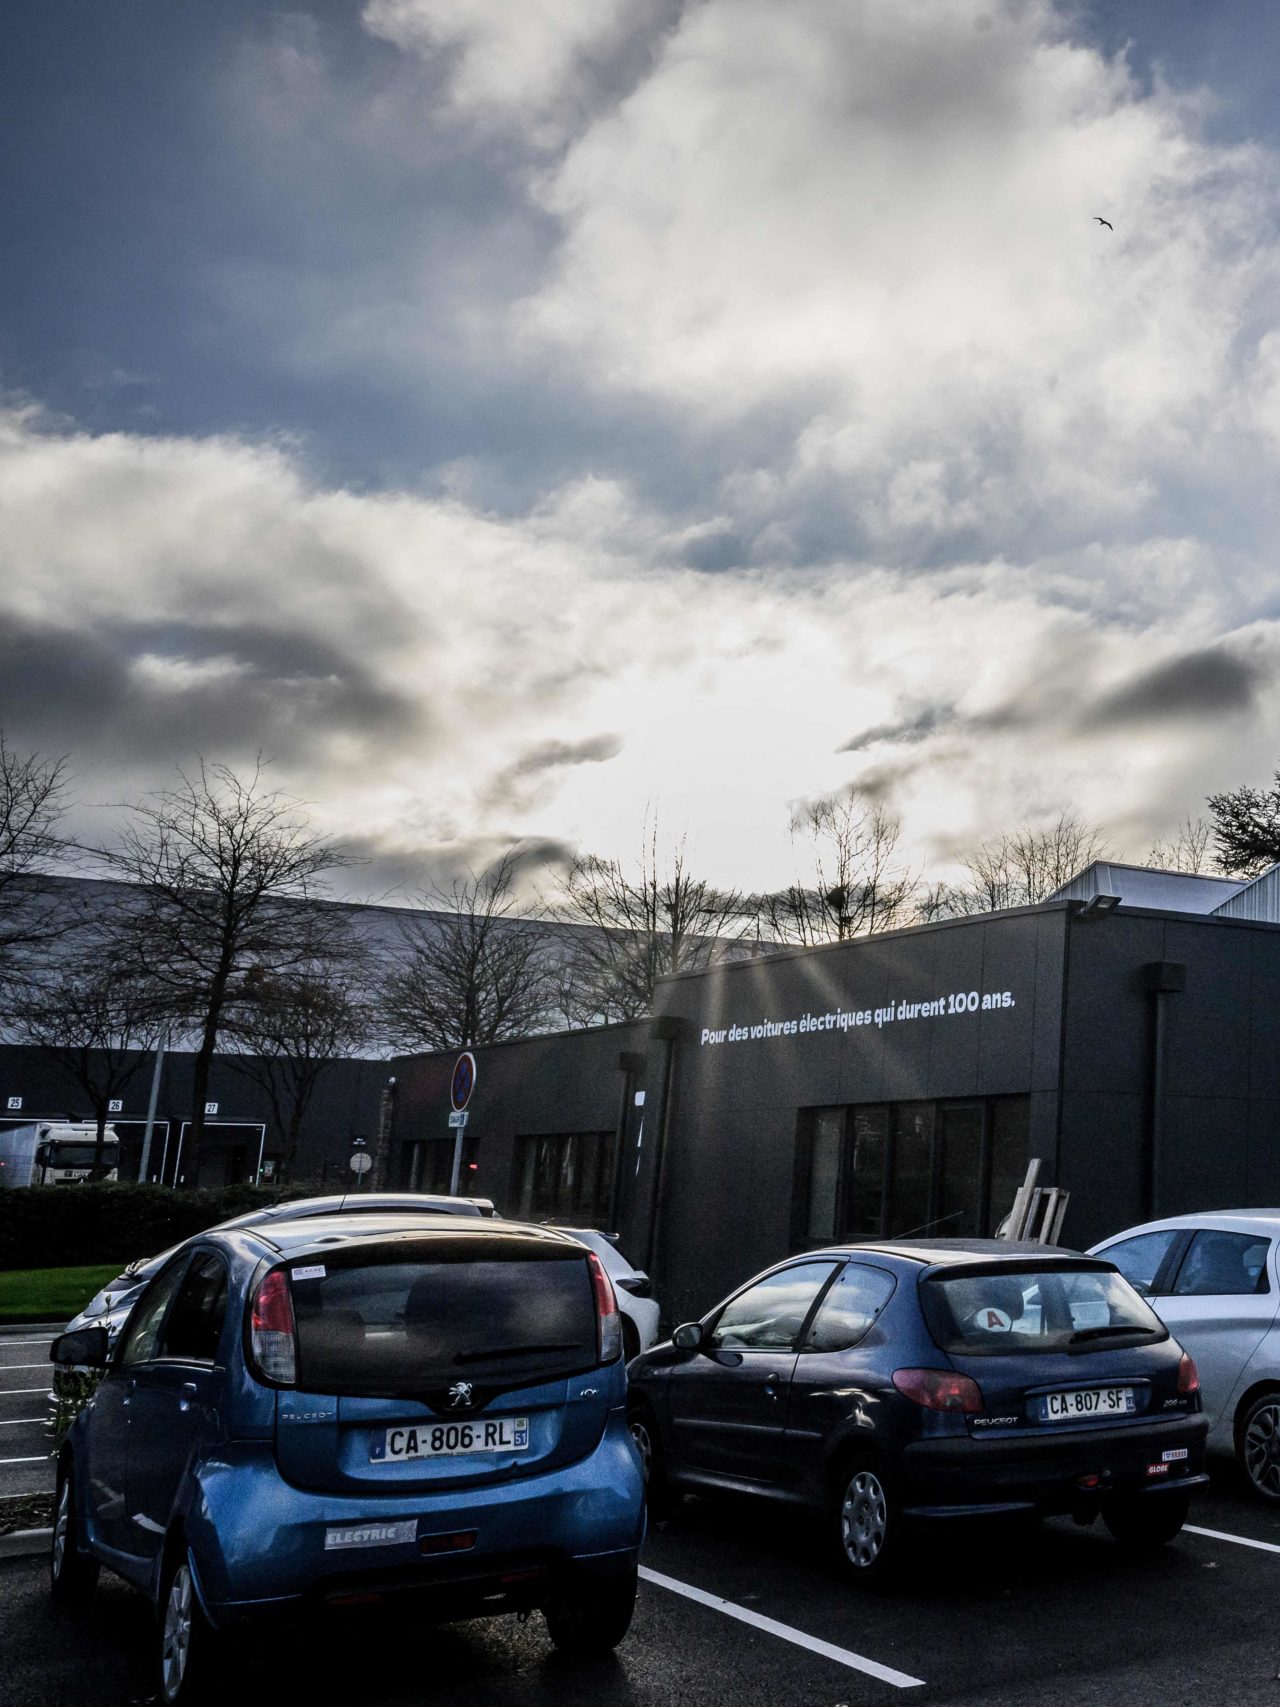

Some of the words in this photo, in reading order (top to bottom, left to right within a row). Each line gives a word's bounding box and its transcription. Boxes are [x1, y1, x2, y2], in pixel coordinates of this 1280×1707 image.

[701, 1028, 727, 1046] Pour
[728, 1023, 749, 1042] des
[750, 1018, 798, 1039] voitures
[799, 1007, 872, 1033] électriques
[874, 1000, 895, 1028] qui
[897, 997, 946, 1020] durent
[947, 991, 980, 1014] 100
[981, 991, 1016, 1010] ans.
[10, 1098, 20, 1108] 25
[111, 1101, 120, 1110] 26
[207, 1104, 216, 1113] 27
[986, 1310, 1005, 1329] A
[1049, 1389, 1124, 1415] CA-807-SF
[974, 1416, 1019, 1426] PEUGEOT
[390, 1421, 511, 1456] CA-806-RL
[515, 1432, 527, 1444] 51
[327, 1527, 397, 1545] ELECTRIC
